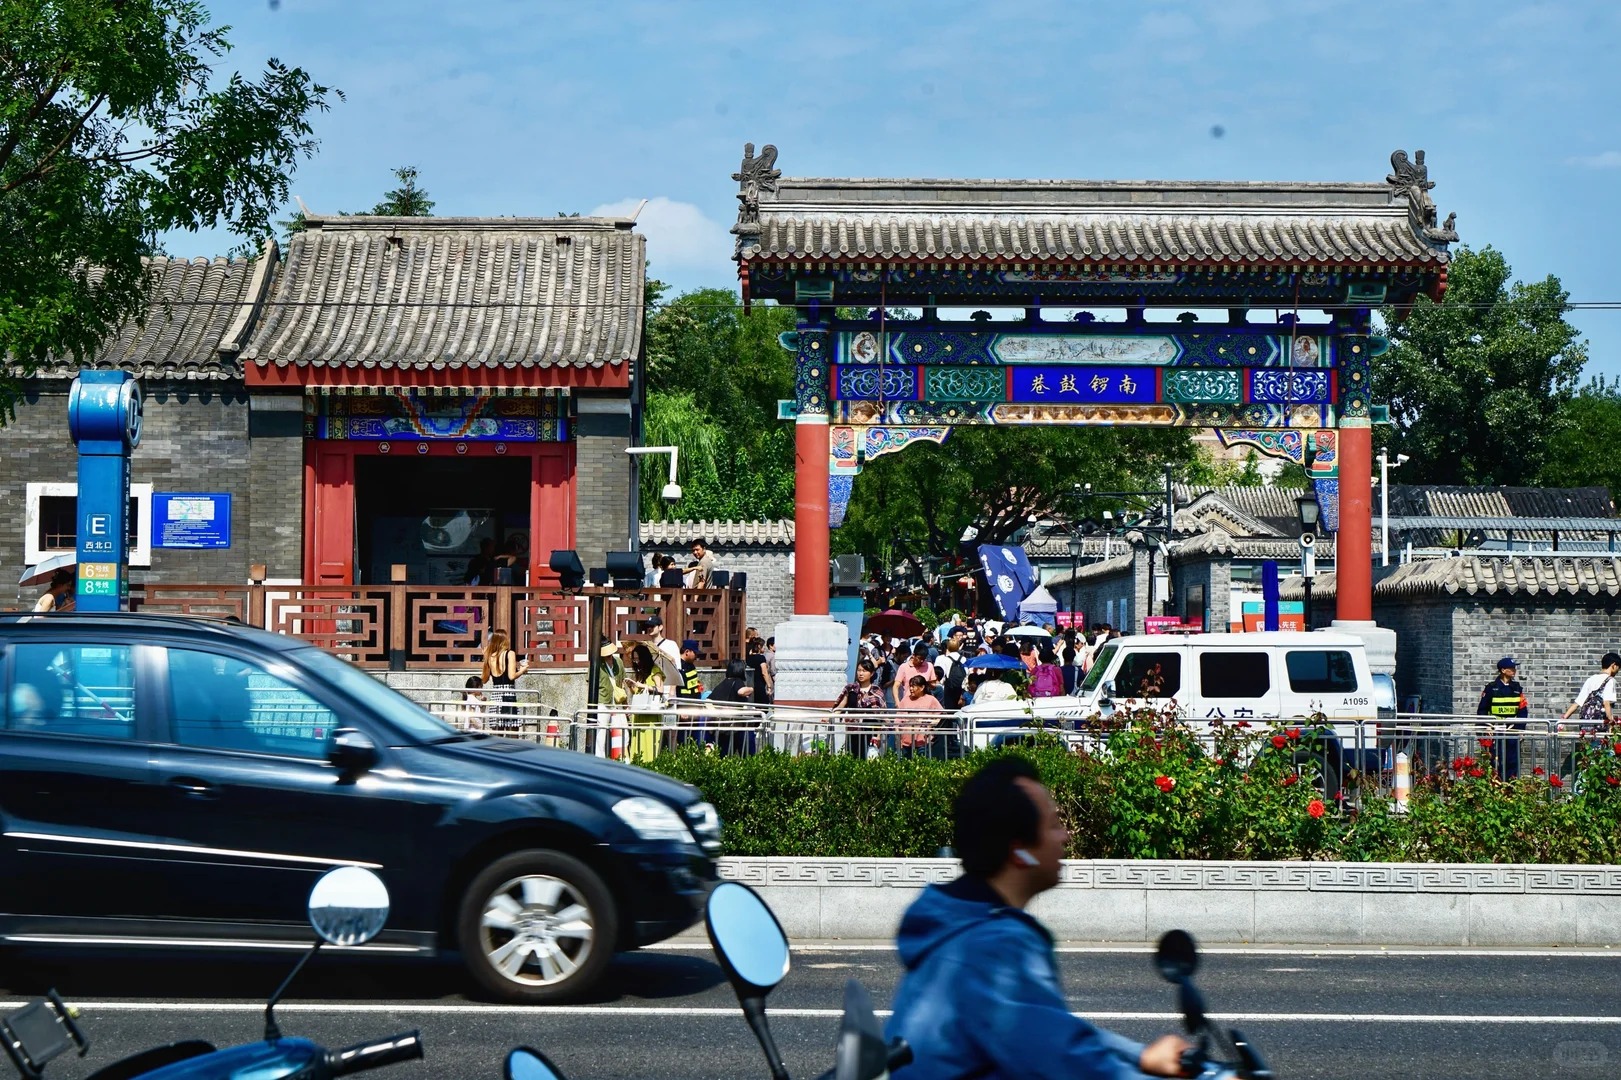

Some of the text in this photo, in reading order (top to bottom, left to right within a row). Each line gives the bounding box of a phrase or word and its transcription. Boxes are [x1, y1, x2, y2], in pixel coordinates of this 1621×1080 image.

[1030, 373, 1137, 394] 南锣鼓巷
[92, 517, 106, 534] E
[85, 541, 112, 549] 西北口
[85, 580, 110, 593] 8号线
[1342, 697, 1369, 706] A1095
